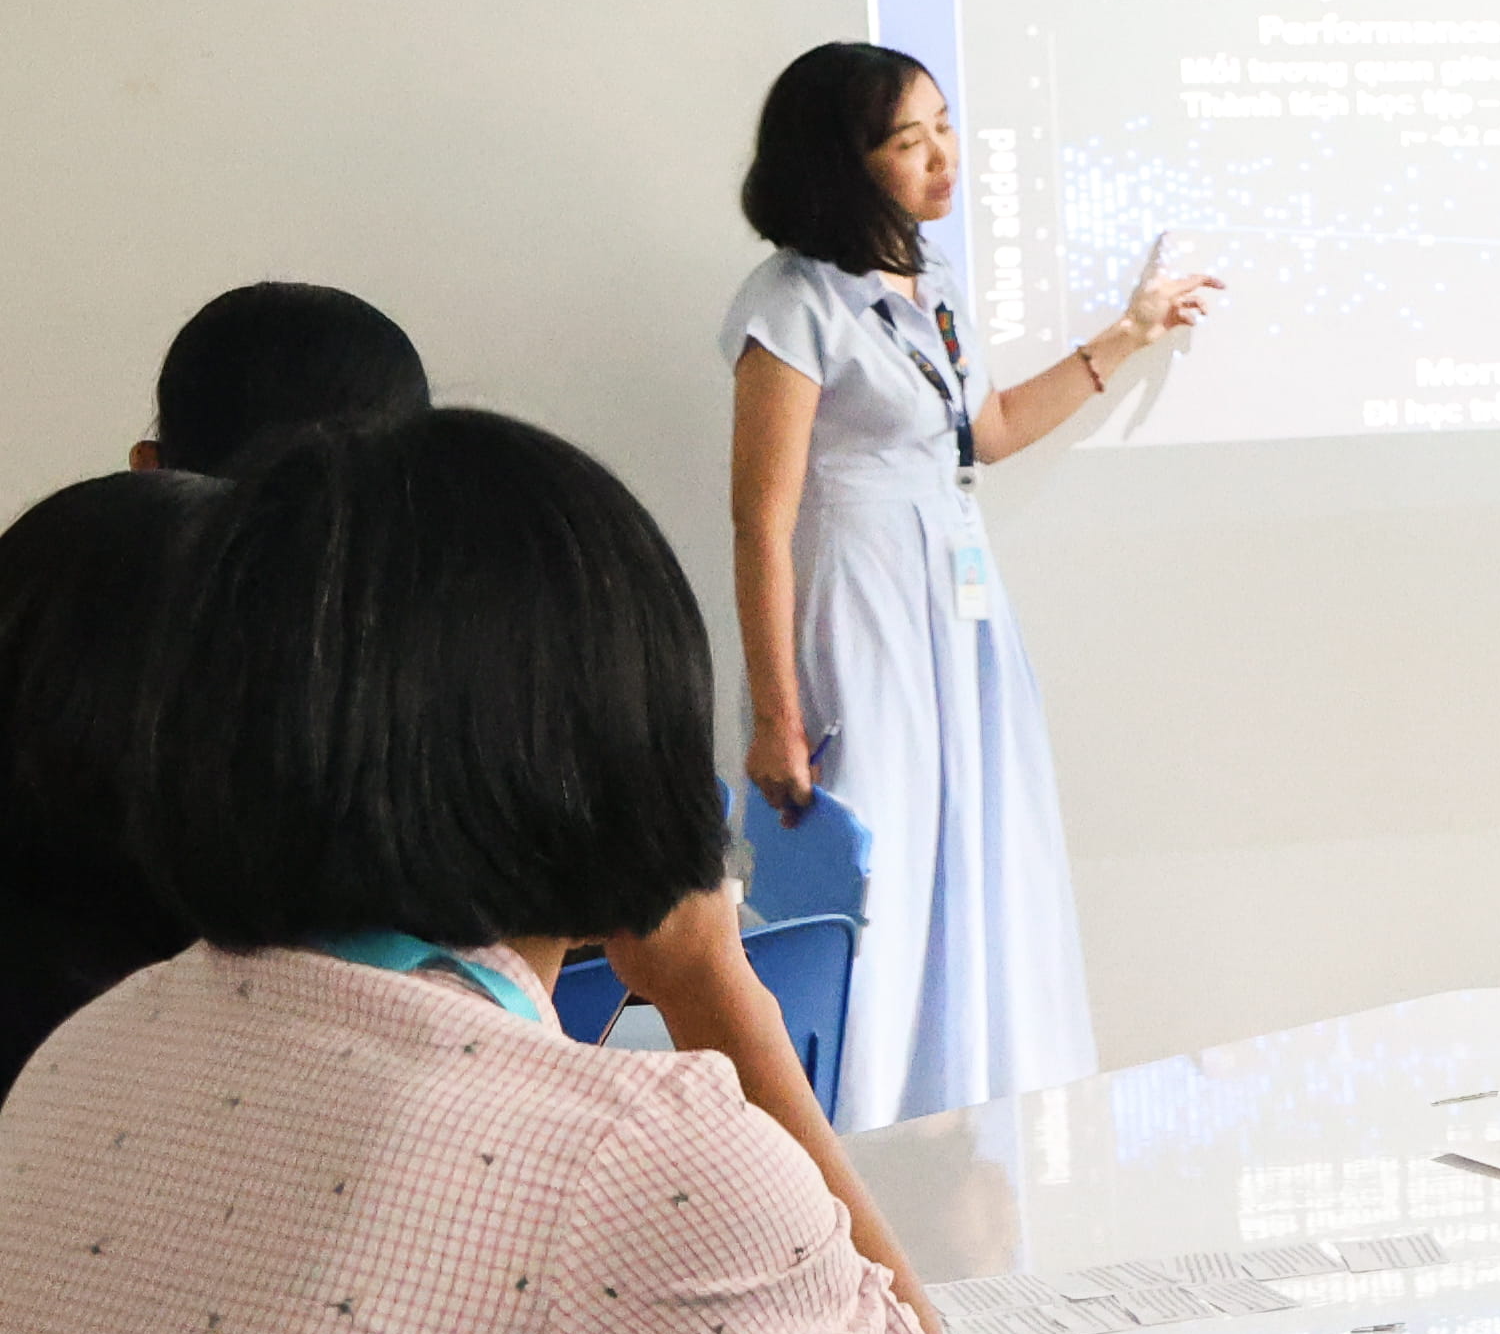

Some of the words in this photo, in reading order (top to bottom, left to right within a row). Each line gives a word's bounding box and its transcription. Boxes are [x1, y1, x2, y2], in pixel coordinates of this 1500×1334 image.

[1259, 12, 1500, 45] Performance
[977, 128, 1020, 239] added
[985, 246, 1026, 346] Value
